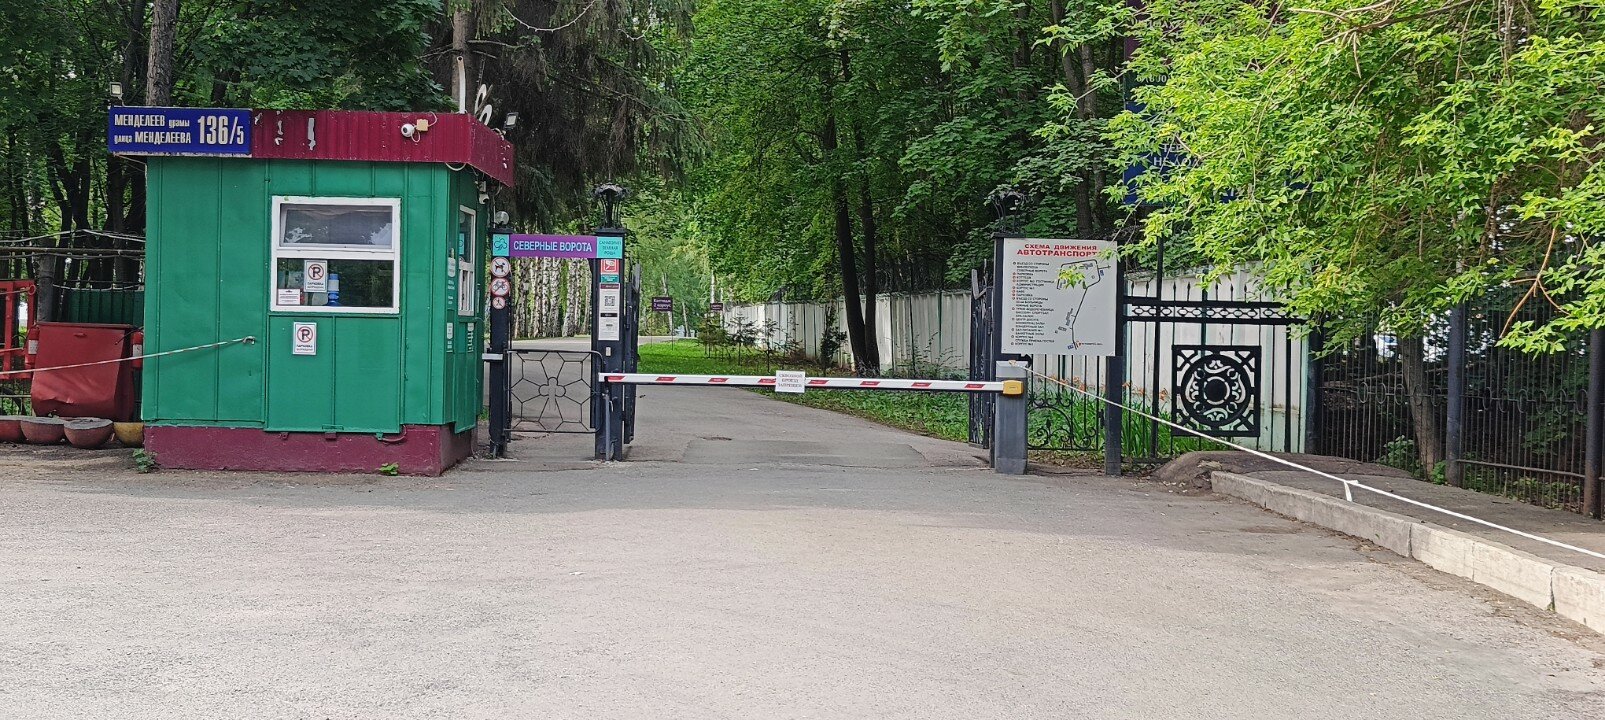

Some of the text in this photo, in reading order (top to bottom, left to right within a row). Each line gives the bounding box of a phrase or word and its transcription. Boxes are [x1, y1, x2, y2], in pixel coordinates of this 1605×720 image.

[114, 114, 190, 128] МЕНДЕЛЕЕВ урамы
[198, 115, 244, 145] 136/5
[114, 131, 191, 145] улица МЕНДЕЛЕЕВА
[513, 240, 592, 252] СЕВЕРНЫЕ ВОРОТА
